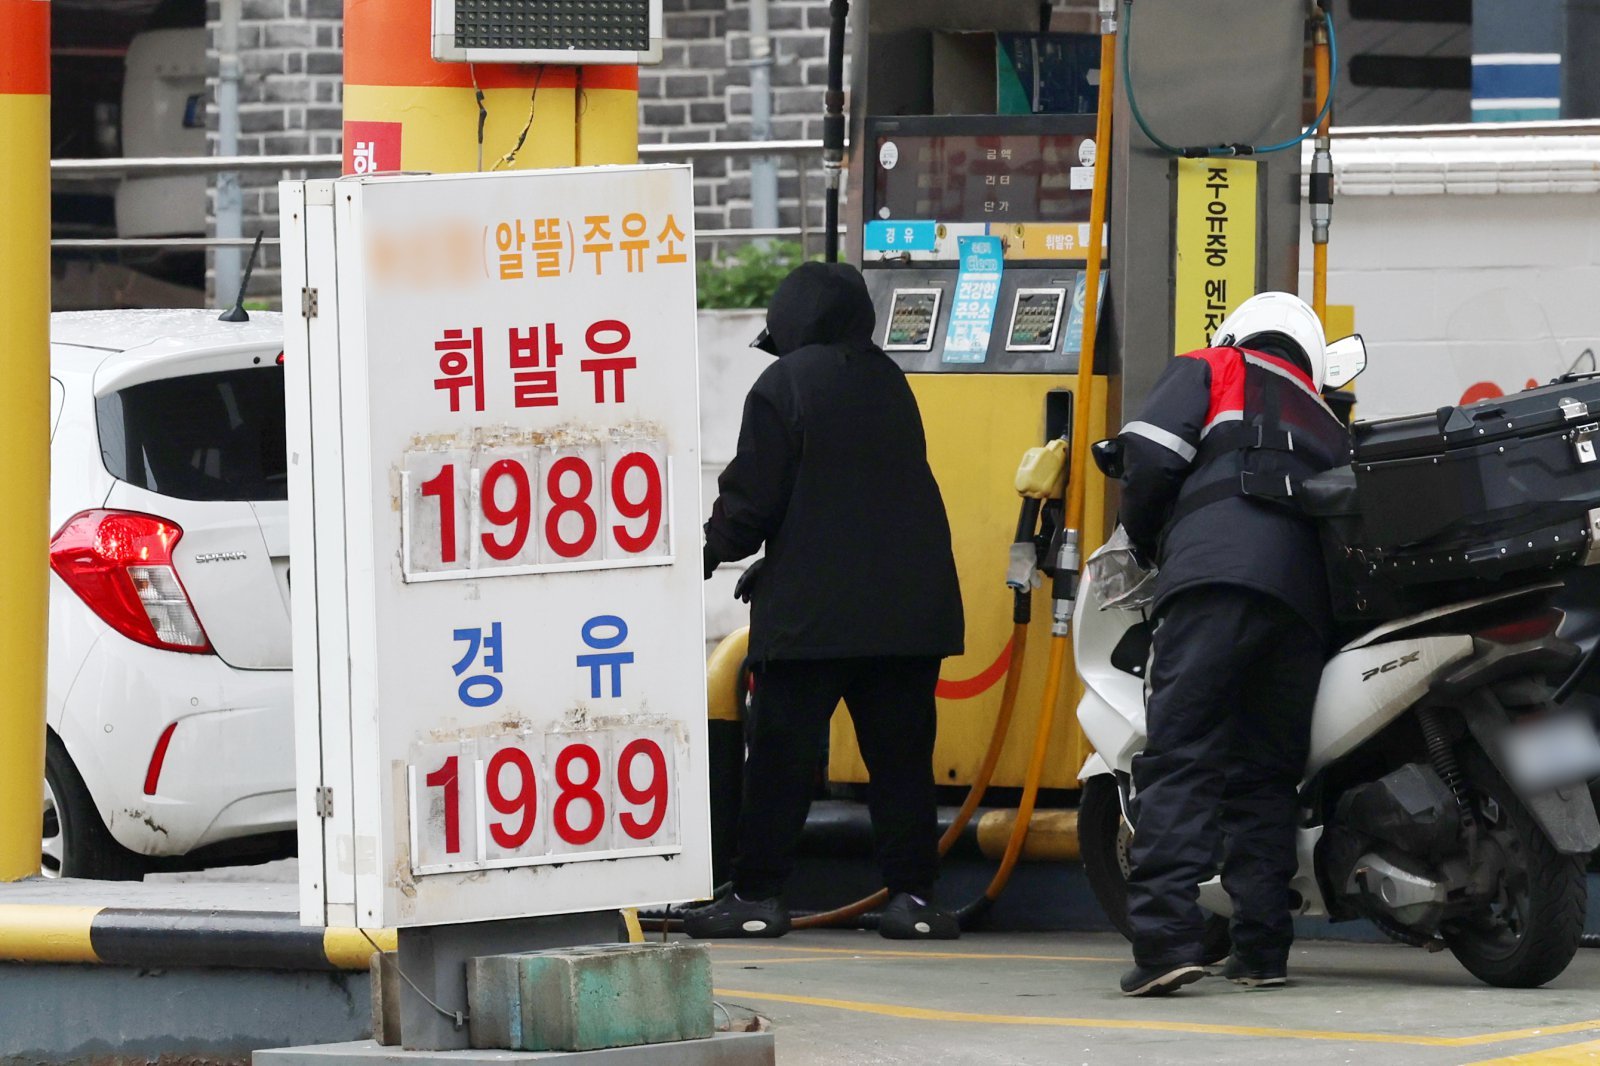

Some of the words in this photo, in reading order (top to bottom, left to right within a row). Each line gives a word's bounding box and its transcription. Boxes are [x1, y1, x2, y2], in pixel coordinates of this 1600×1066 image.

[1205, 167, 1229, 267] 주유중
[434, 319, 637, 412] 휘발유
[421, 451, 663, 563] 1989
[196, 551, 248, 564] SPARK
[452, 614, 635, 708] 경유
[1361, 651, 1420, 682] PCX
[426, 738, 669, 853] 1989
